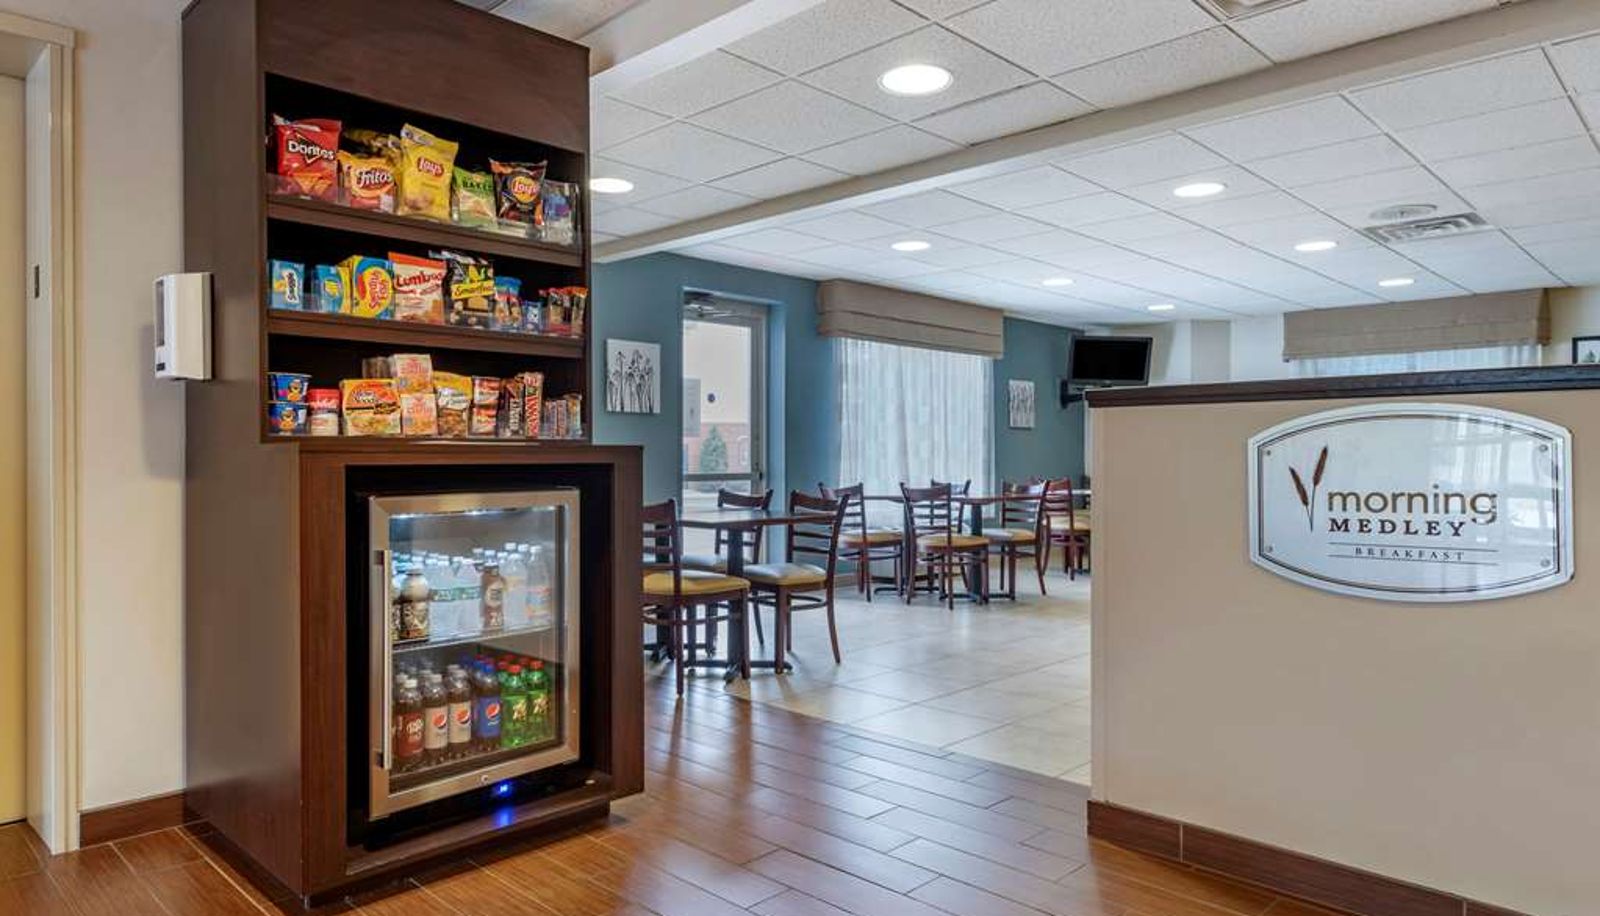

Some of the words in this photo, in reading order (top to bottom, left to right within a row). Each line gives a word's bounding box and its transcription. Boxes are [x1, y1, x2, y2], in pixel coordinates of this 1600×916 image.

[288, 140, 335, 160] Doritos
[356, 168, 393, 188] Fritos
[1327, 483, 1497, 525] morning
[1328, 518, 1467, 537] MEDLEY
[1355, 546, 1466, 561] BREAKFAST
